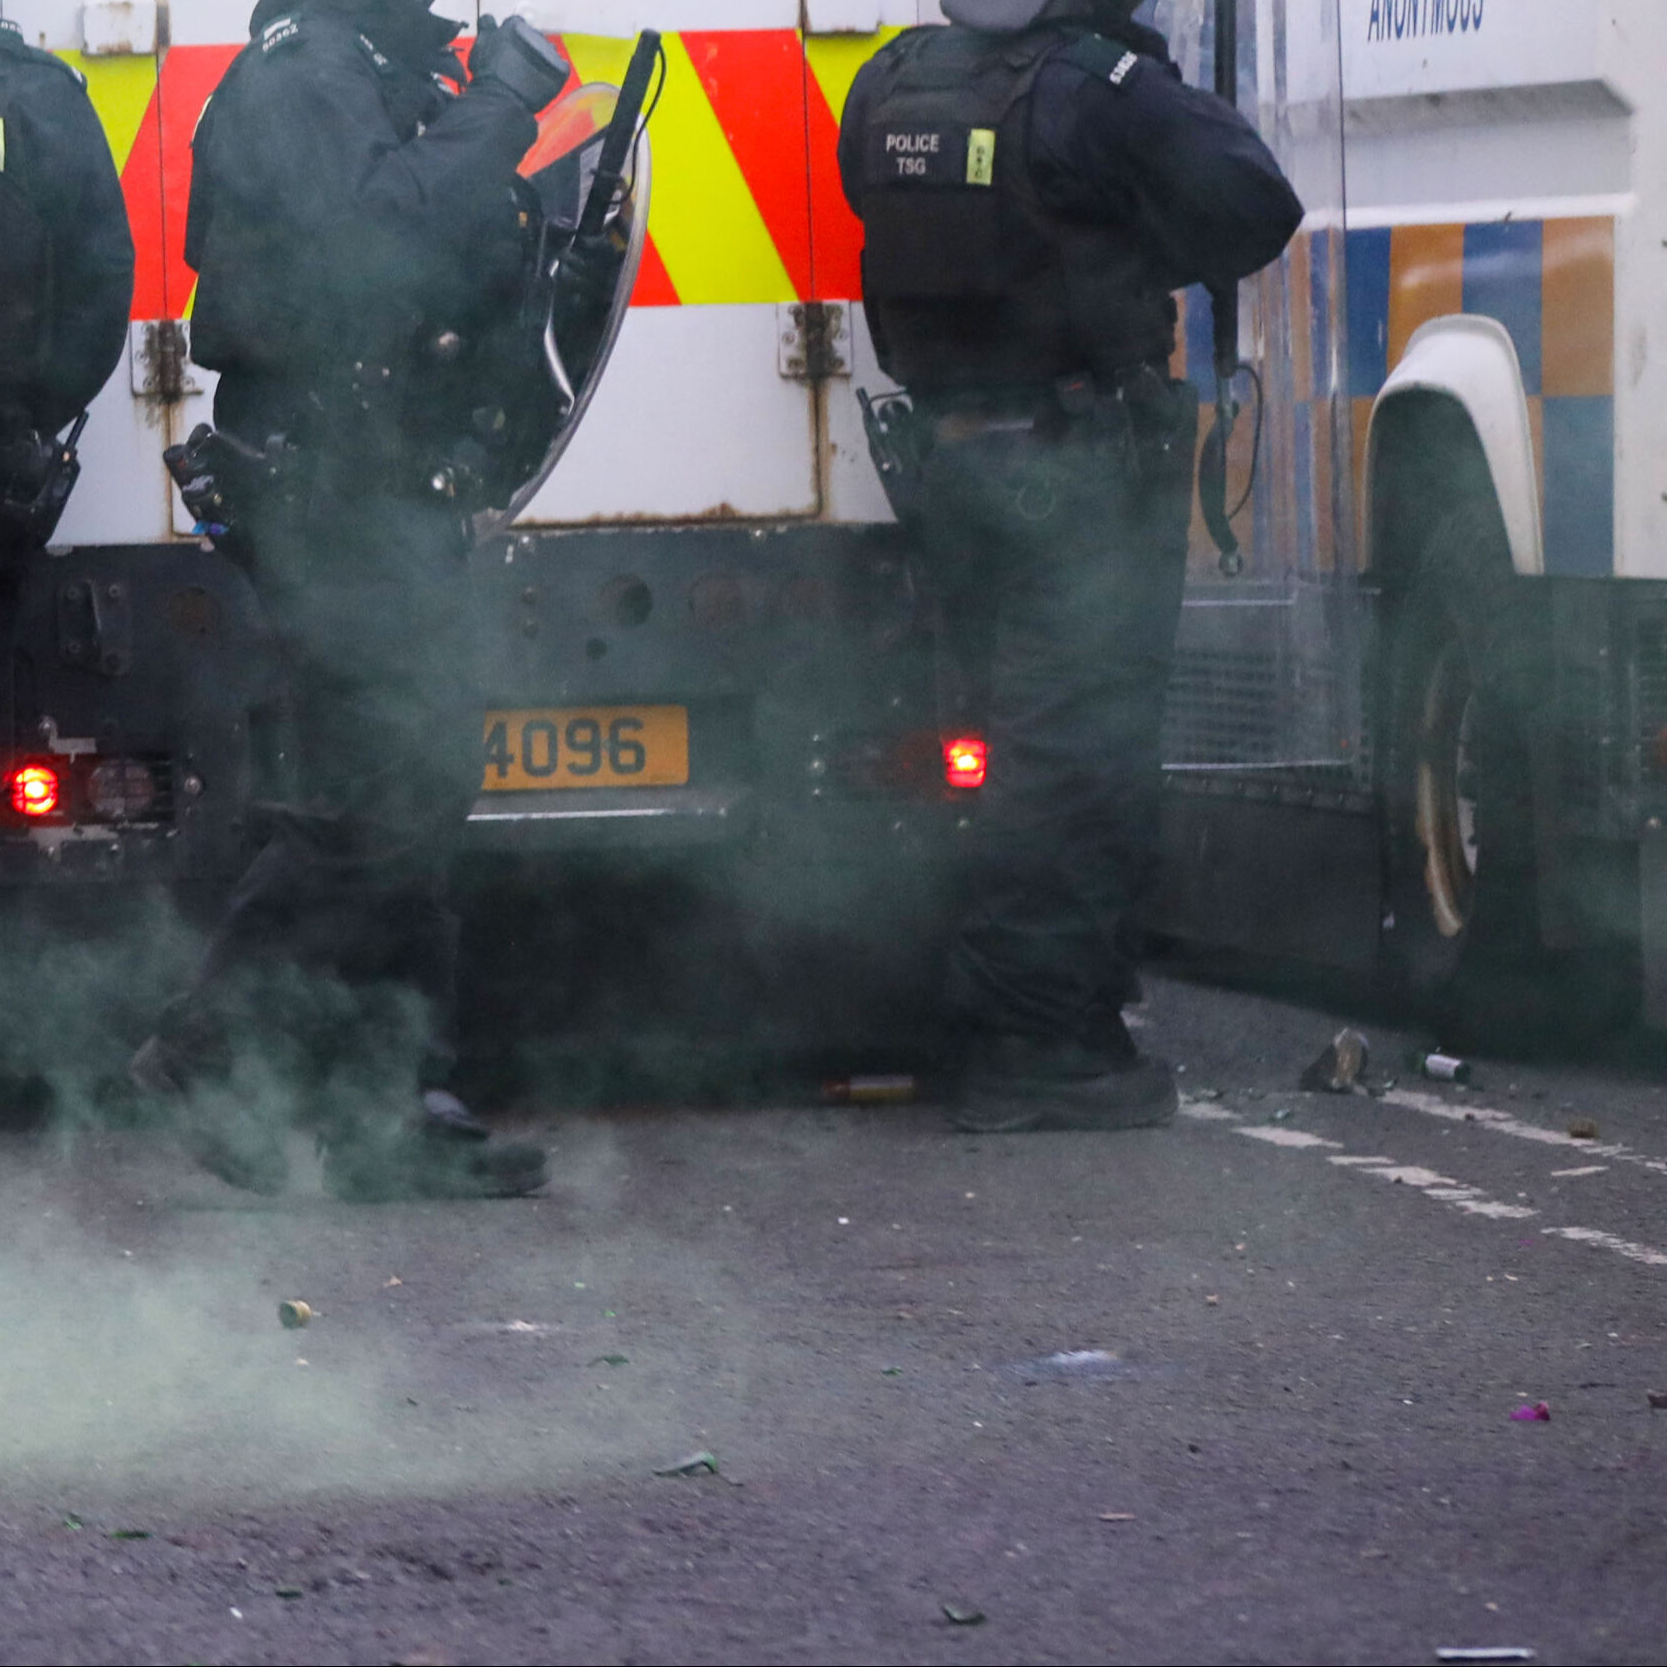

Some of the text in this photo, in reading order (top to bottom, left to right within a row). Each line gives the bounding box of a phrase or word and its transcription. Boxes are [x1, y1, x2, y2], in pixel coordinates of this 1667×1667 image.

[886, 133, 940, 153] POLICE
[895, 156, 927, 175] TSG
[482, 717, 647, 780] 4096
